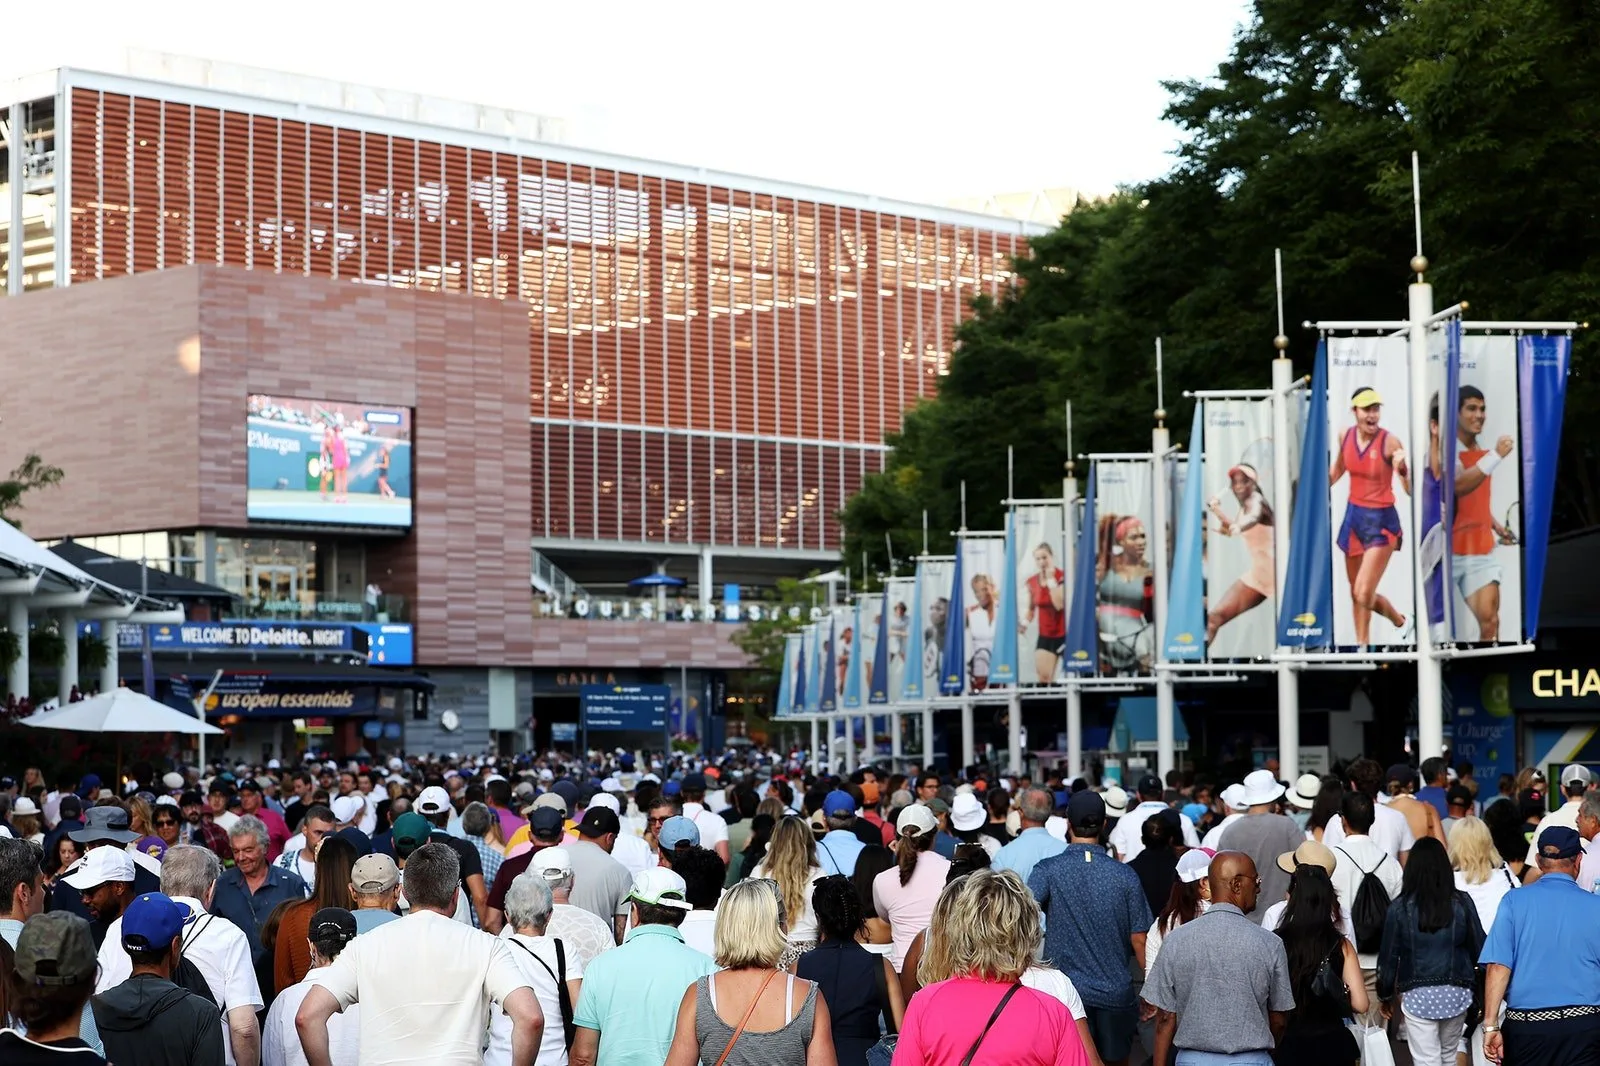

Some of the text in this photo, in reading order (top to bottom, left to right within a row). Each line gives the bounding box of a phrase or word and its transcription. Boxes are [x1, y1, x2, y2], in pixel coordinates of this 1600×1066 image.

[554, 599, 653, 619] LOUIS
[181, 626, 345, 646] WELCOME TO Deloitte. NIGHT
[1531, 668, 1600, 698] CHA
[222, 690, 355, 712] us open essentials
